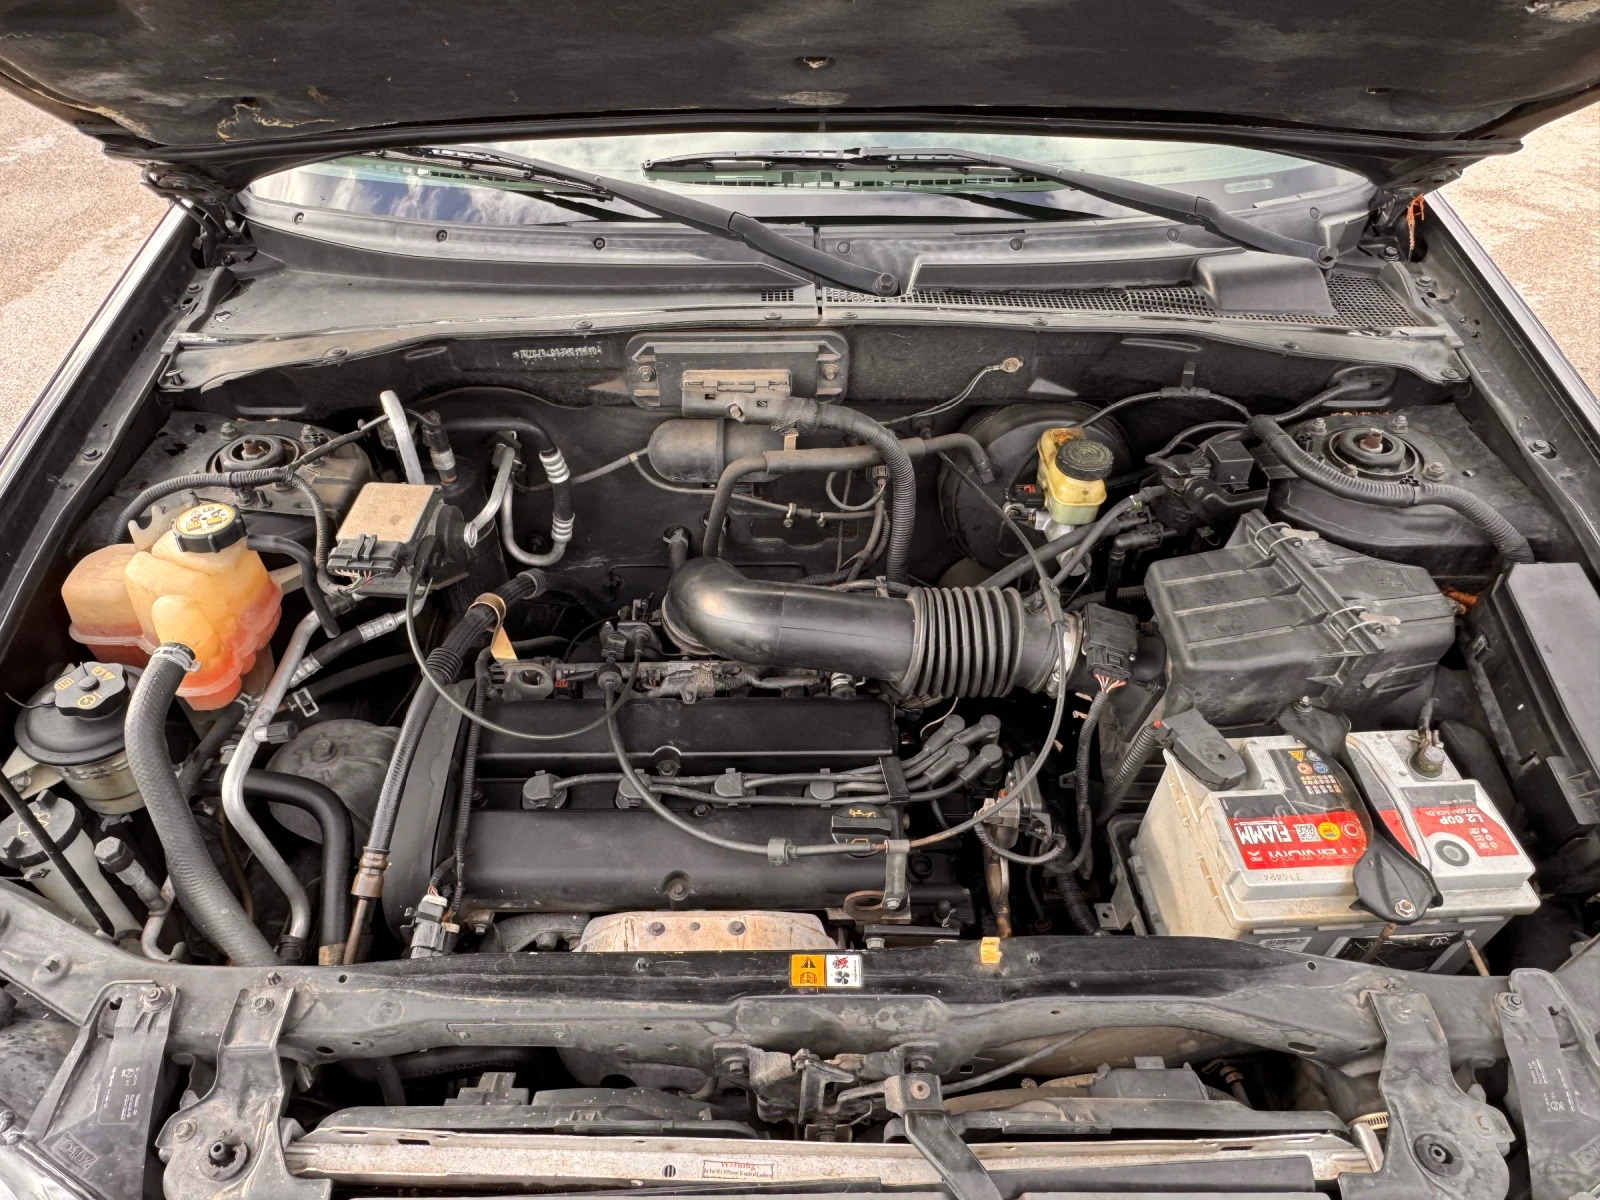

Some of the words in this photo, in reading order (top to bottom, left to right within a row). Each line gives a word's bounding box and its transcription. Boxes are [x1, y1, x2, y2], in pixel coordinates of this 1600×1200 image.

[1439, 815, 1465, 825] 60P
[1465, 813, 1484, 823] L2
[1235, 823, 1293, 845] FIAMM
